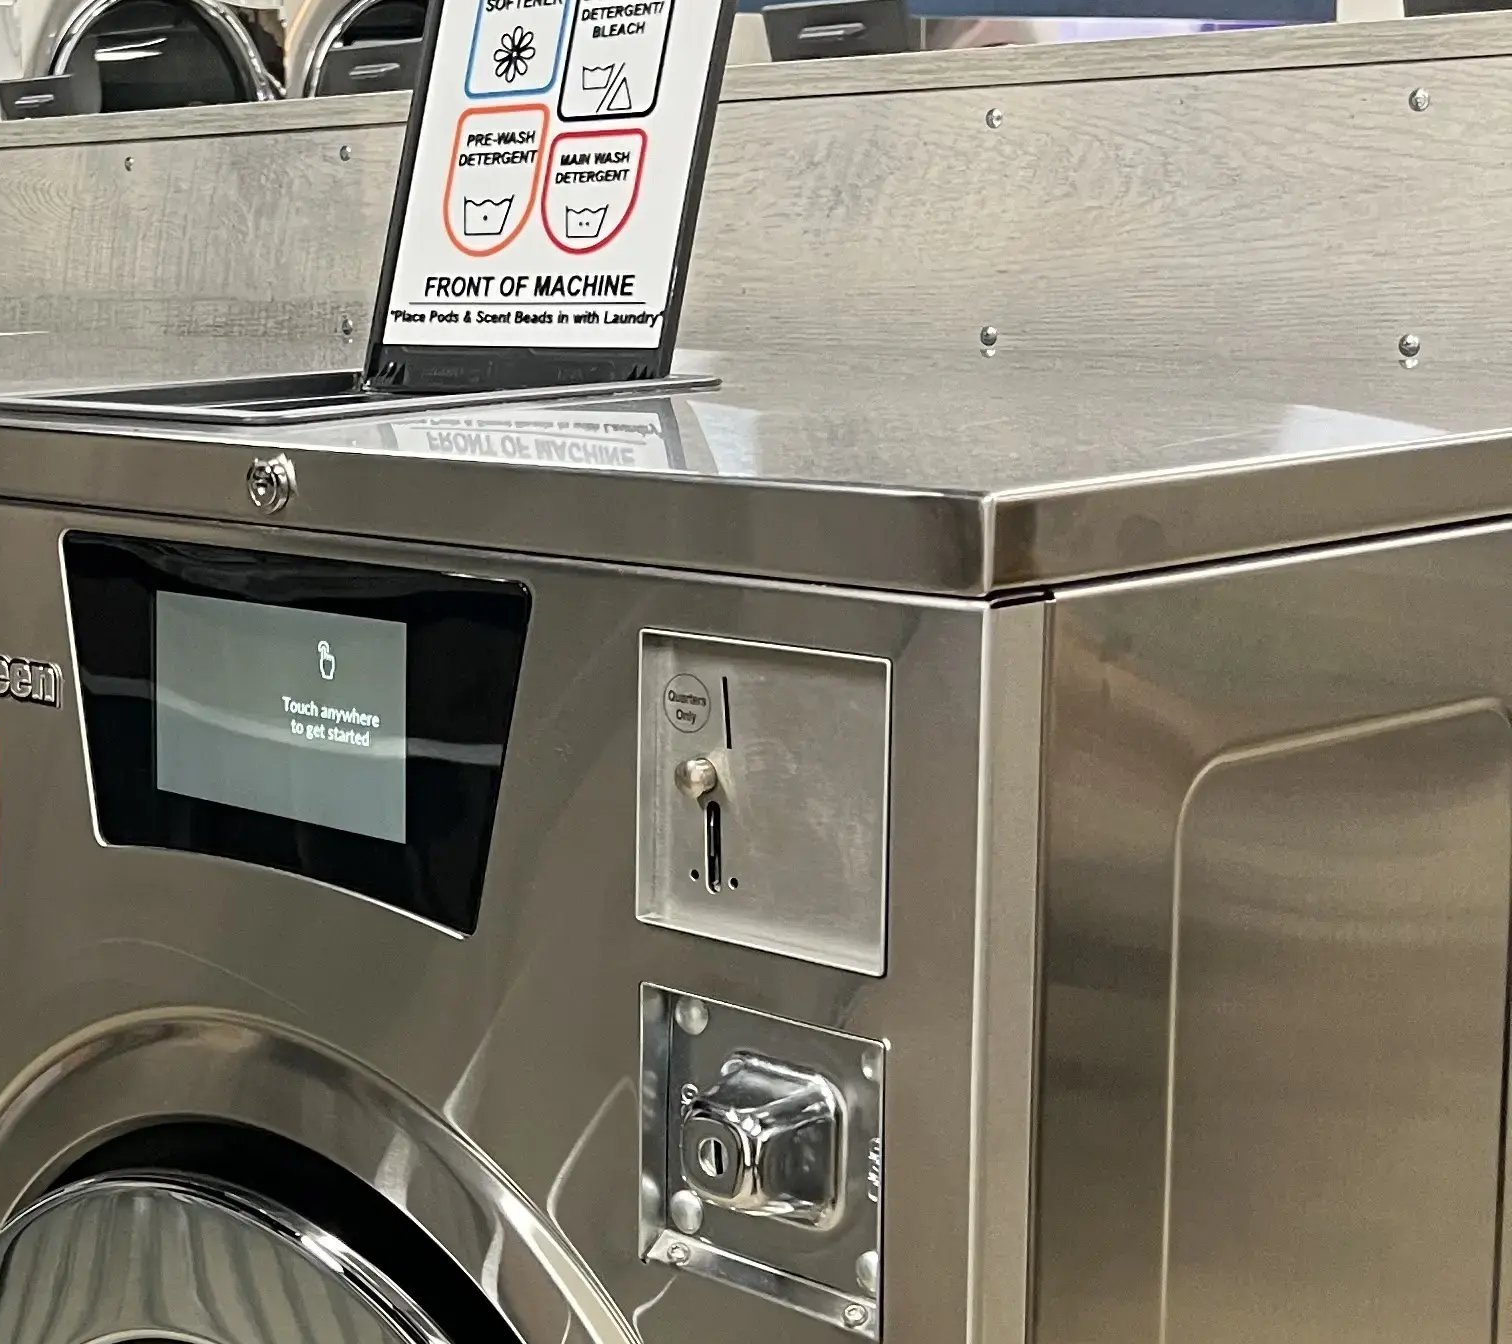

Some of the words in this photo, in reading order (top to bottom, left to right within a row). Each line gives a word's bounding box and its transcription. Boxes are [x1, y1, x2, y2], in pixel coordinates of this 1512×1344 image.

[592, 21, 646, 39] BLEACH
[466, 130, 536, 148] PRE-WASH
[458, 149, 538, 168] DETERGENT
[559, 152, 591, 167] MAIN
[594, 150, 630, 165] WASH
[554, 169, 629, 185] DETERGENT
[423, 275, 497, 298] FRONT
[499, 275, 529, 298] OF
[533, 274, 636, 298] MACHINE
[429, 310, 459, 324] Pods
[463, 310, 472, 324] &
[475, 310, 512, 324] Scent
[514, 310, 554, 325] Beads
[557, 310, 569, 324] in
[573, 310, 600, 325] with
[282, 695, 319, 717] Touch
[320, 707, 381, 728] anywhere
[290, 718, 305, 735] to
[305, 723, 326, 740] get
[327, 726, 370, 747] started
